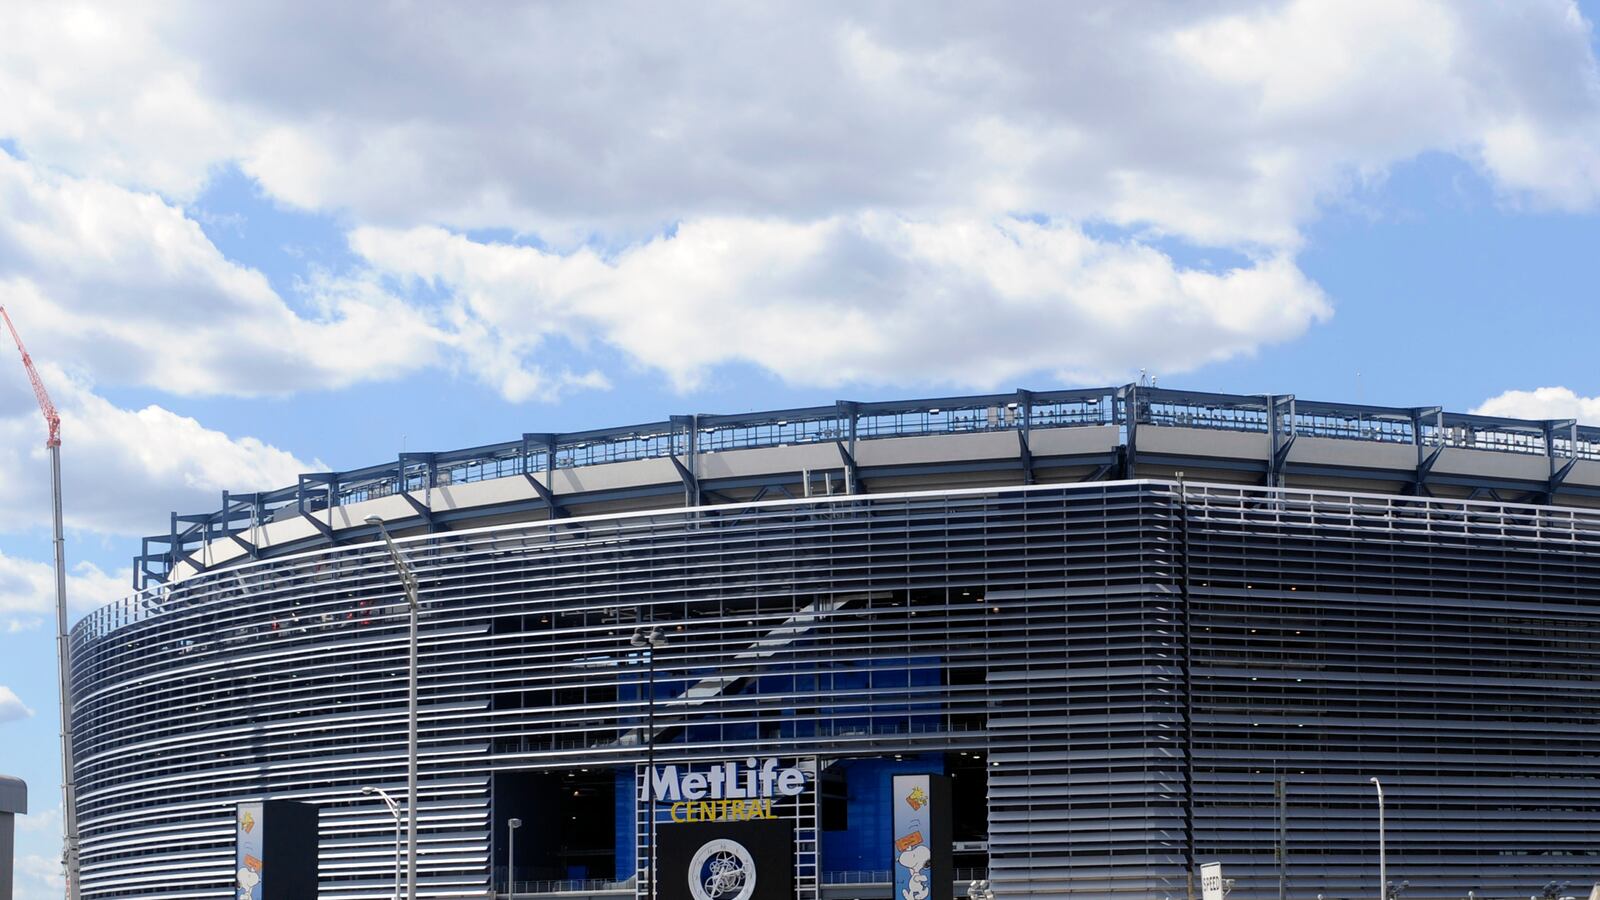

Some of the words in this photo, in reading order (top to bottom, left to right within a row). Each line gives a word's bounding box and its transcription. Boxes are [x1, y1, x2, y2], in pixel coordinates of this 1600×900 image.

[640, 757, 806, 802] MetLife
[670, 798, 779, 823] CENTRAL
[1202, 875, 1220, 892] SPEED
